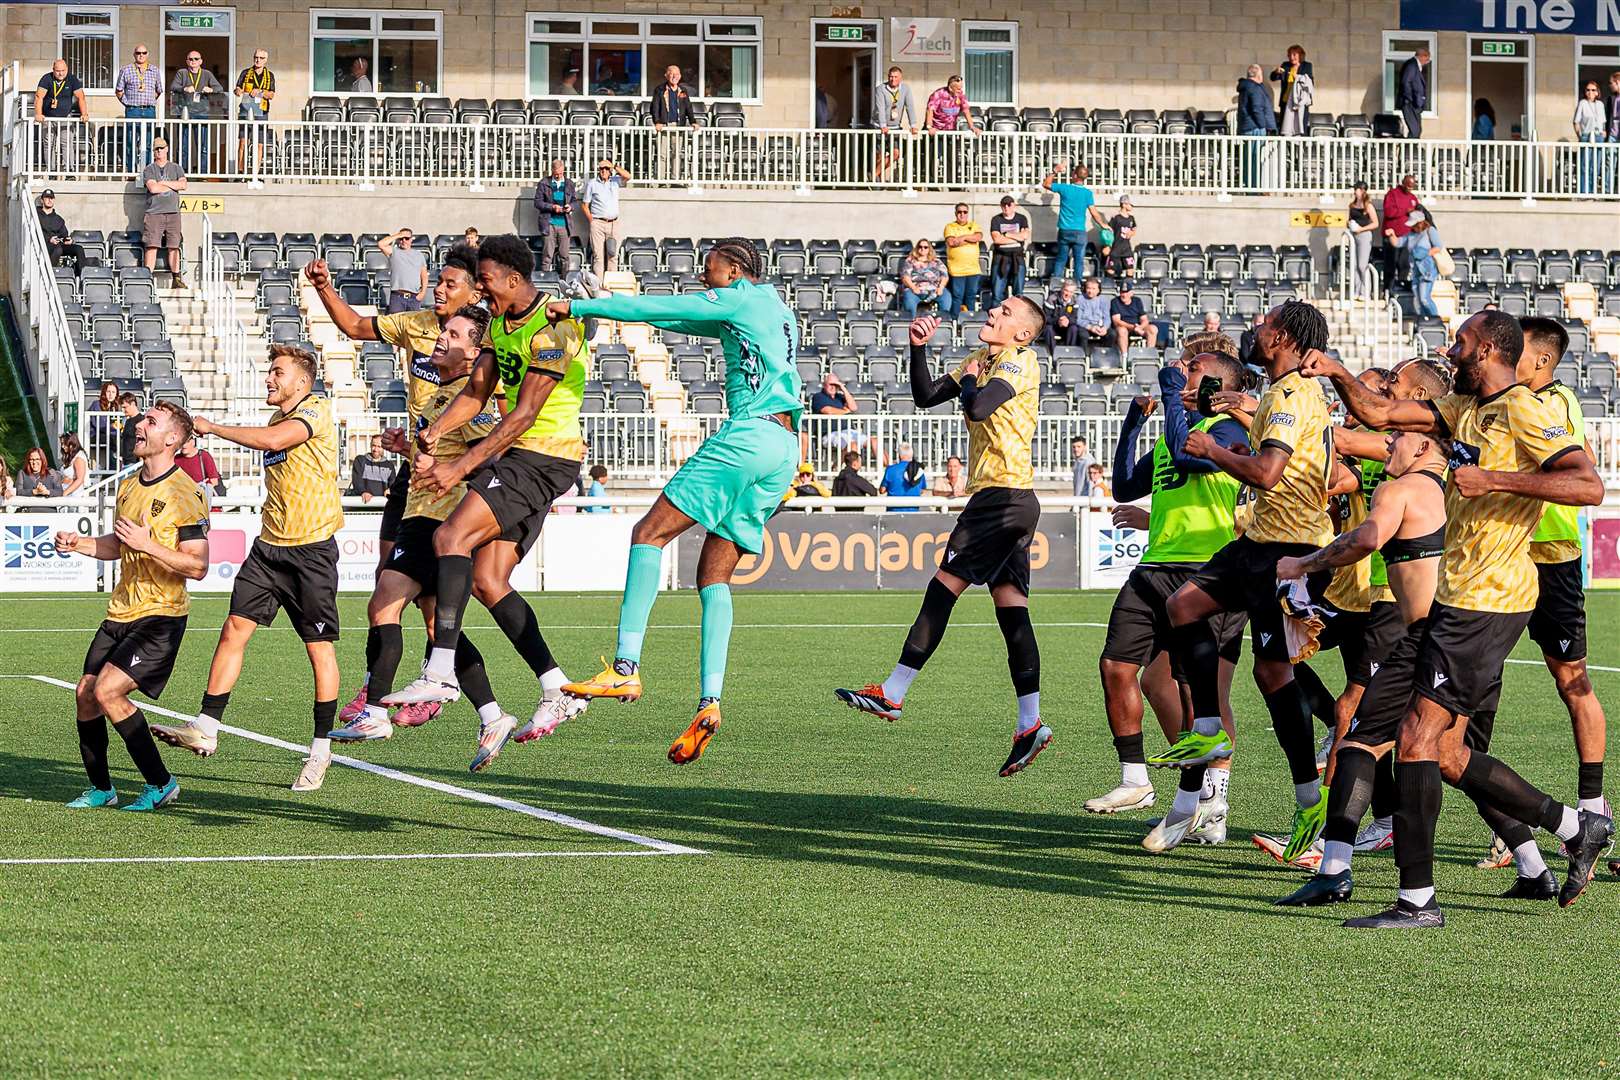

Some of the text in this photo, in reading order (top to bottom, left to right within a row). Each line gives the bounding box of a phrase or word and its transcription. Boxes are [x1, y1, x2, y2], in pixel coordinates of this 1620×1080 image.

[180, 200, 187, 210] A
[202, 200, 208, 211] B
[1323, 215, 1332, 225] C
[339, 540, 374, 555] ON
[777, 531, 1050, 572] vanaraa
